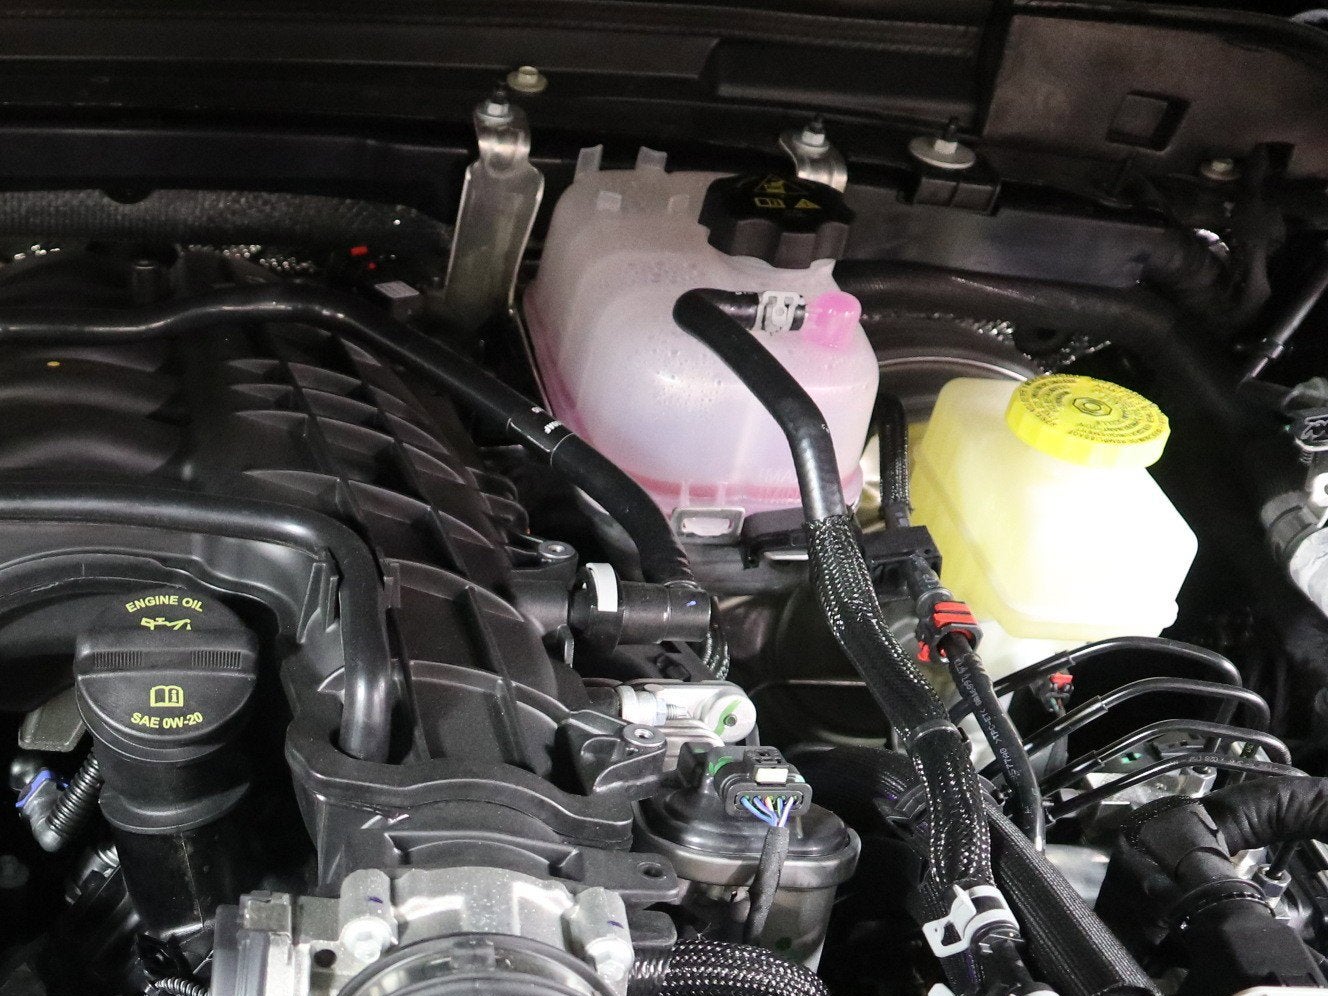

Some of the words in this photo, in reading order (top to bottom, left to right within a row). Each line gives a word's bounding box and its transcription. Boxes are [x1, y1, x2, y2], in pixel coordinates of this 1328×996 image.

[125, 595, 179, 613] ENGINE
[181, 597, 203, 612] OIL
[130, 712, 160, 729] SAE
[162, 711, 204, 729] 0W-20
